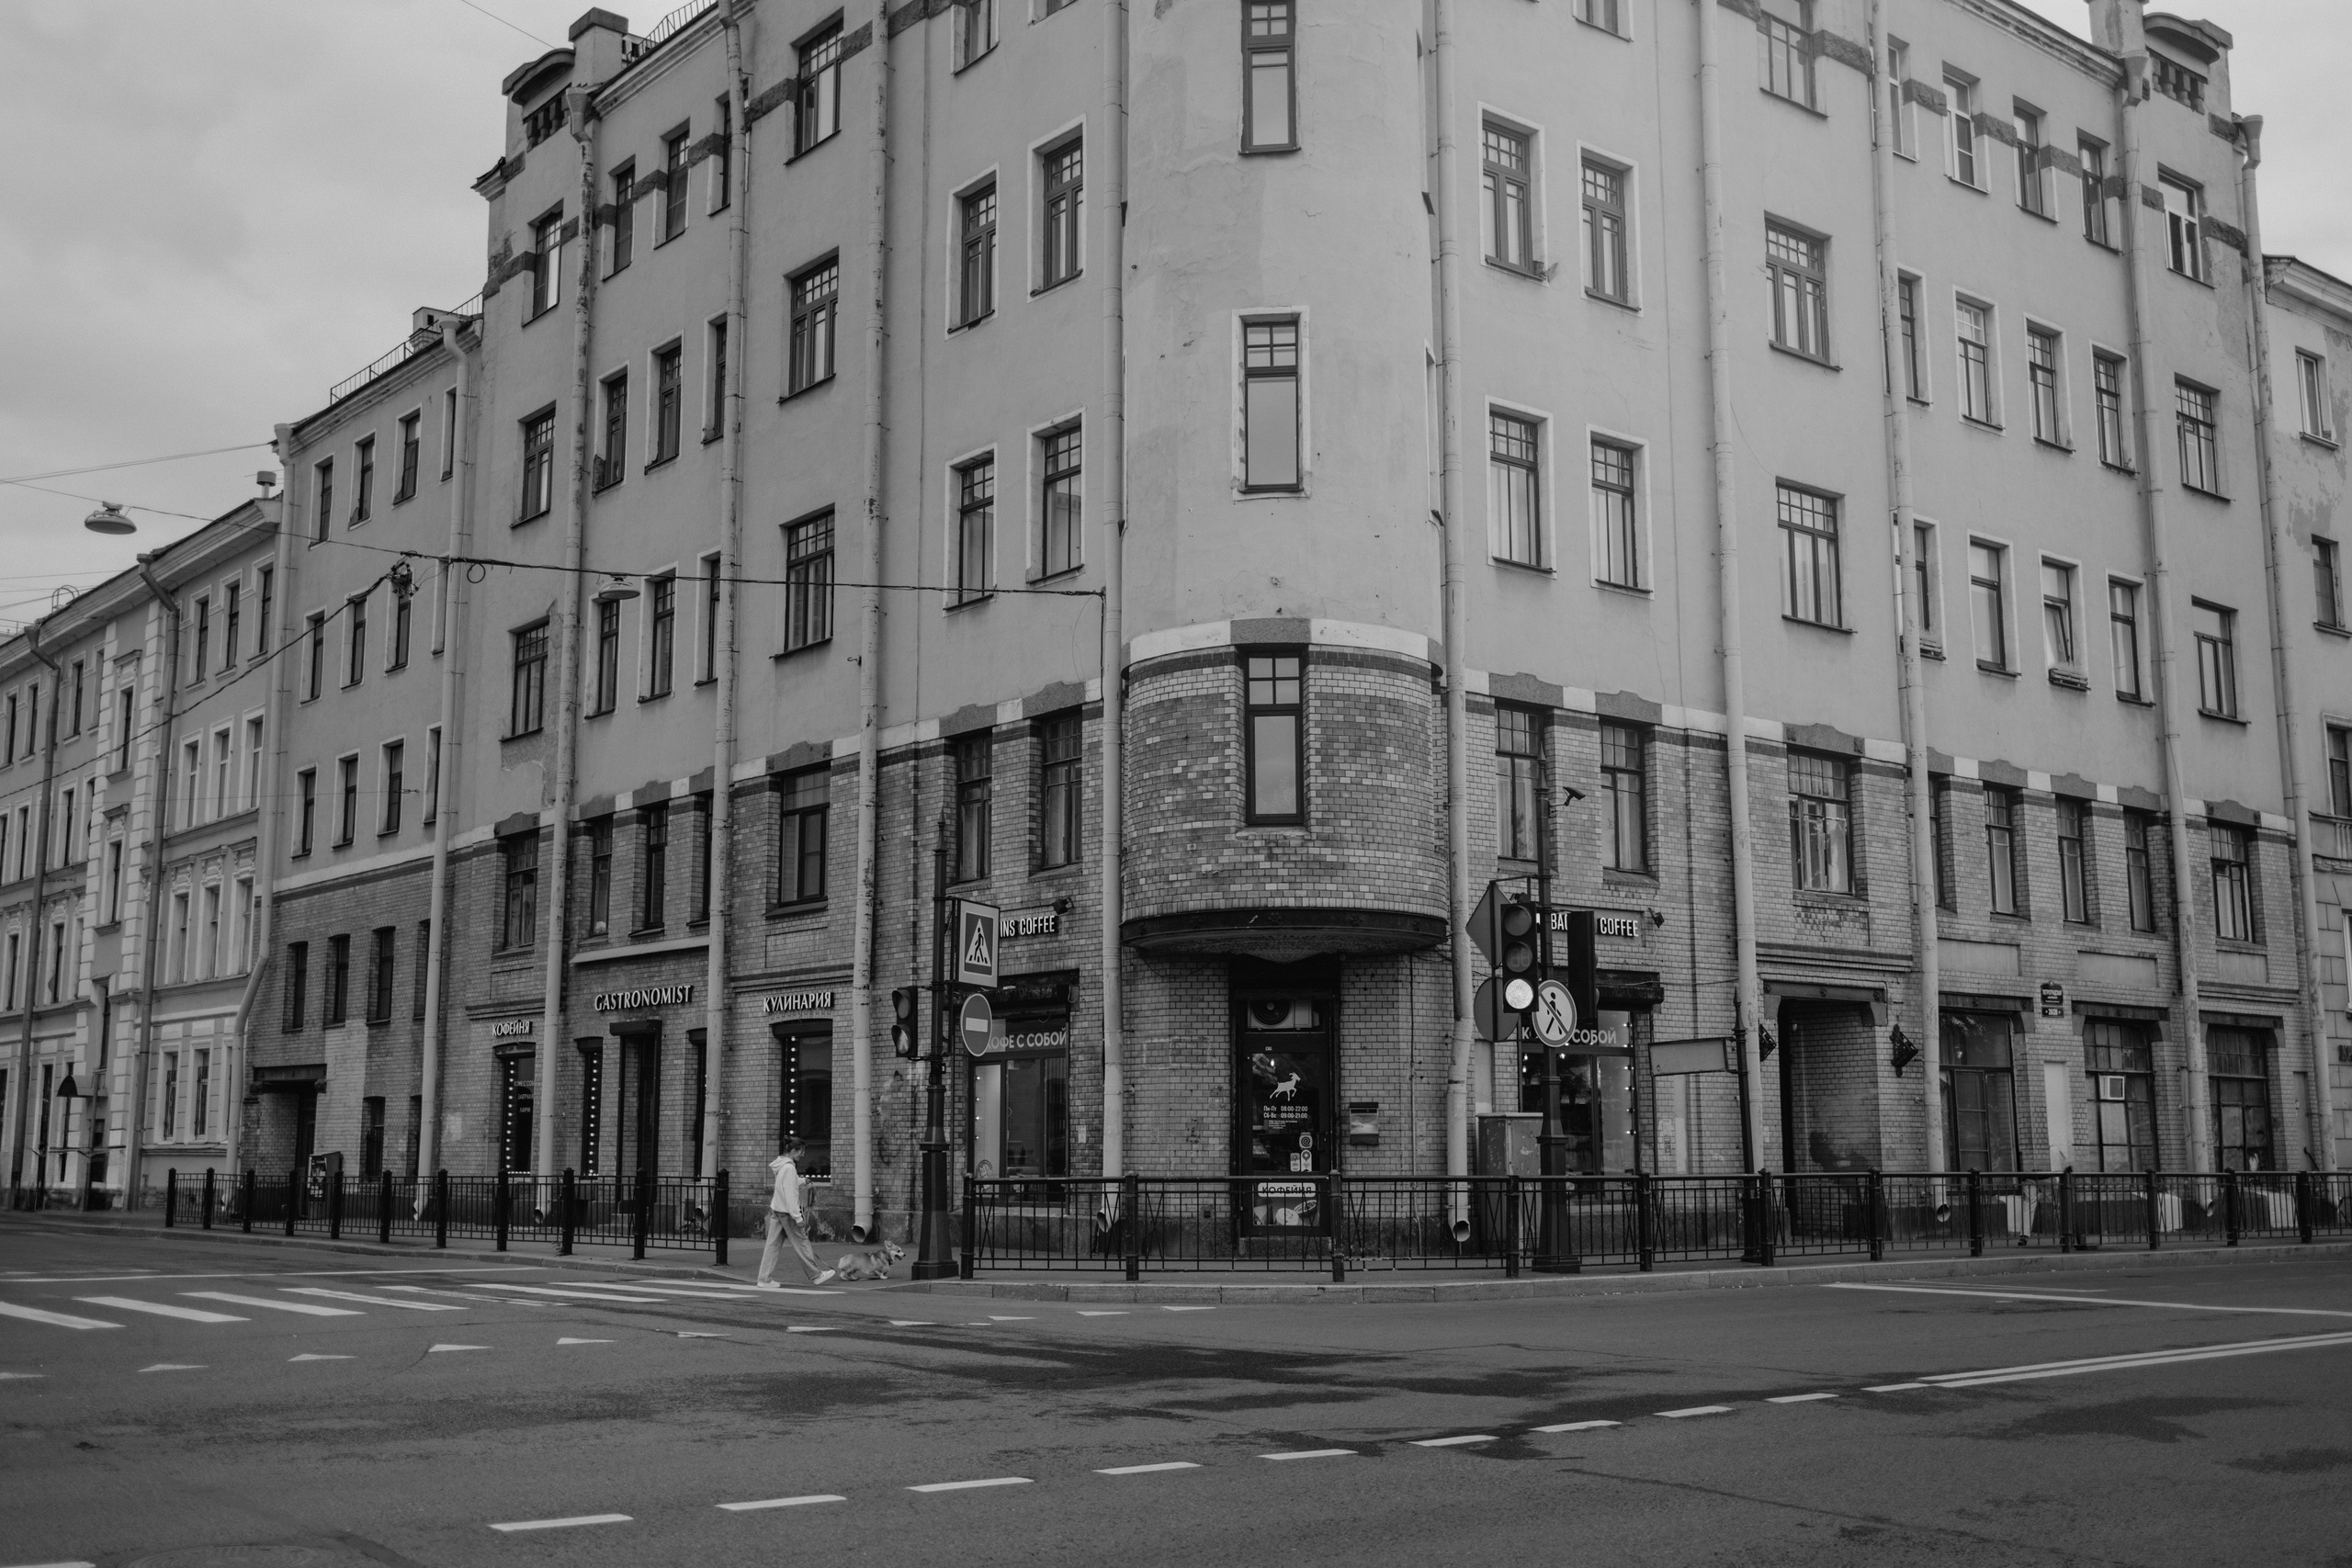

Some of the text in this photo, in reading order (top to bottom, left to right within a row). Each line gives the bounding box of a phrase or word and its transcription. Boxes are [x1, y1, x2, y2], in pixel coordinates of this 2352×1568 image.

[1000, 915, 1055, 938] INS COFFEE
[1600, 917, 1639, 937] COFFEE
[594, 985, 691, 1011] GASTRONOMIST
[763, 991, 831, 1012] КУЛИНАРИЯ
[492, 1020, 530, 1036] КОФЕЙНЯ
[1016, 1033, 1024, 1048] С
[1026, 1027, 1067, 1047] СОБОЙ
[1572, 1026, 1617, 1044] СОБОЙ
[1261, 1184, 1312, 1194] КОФЕЙНЯ
